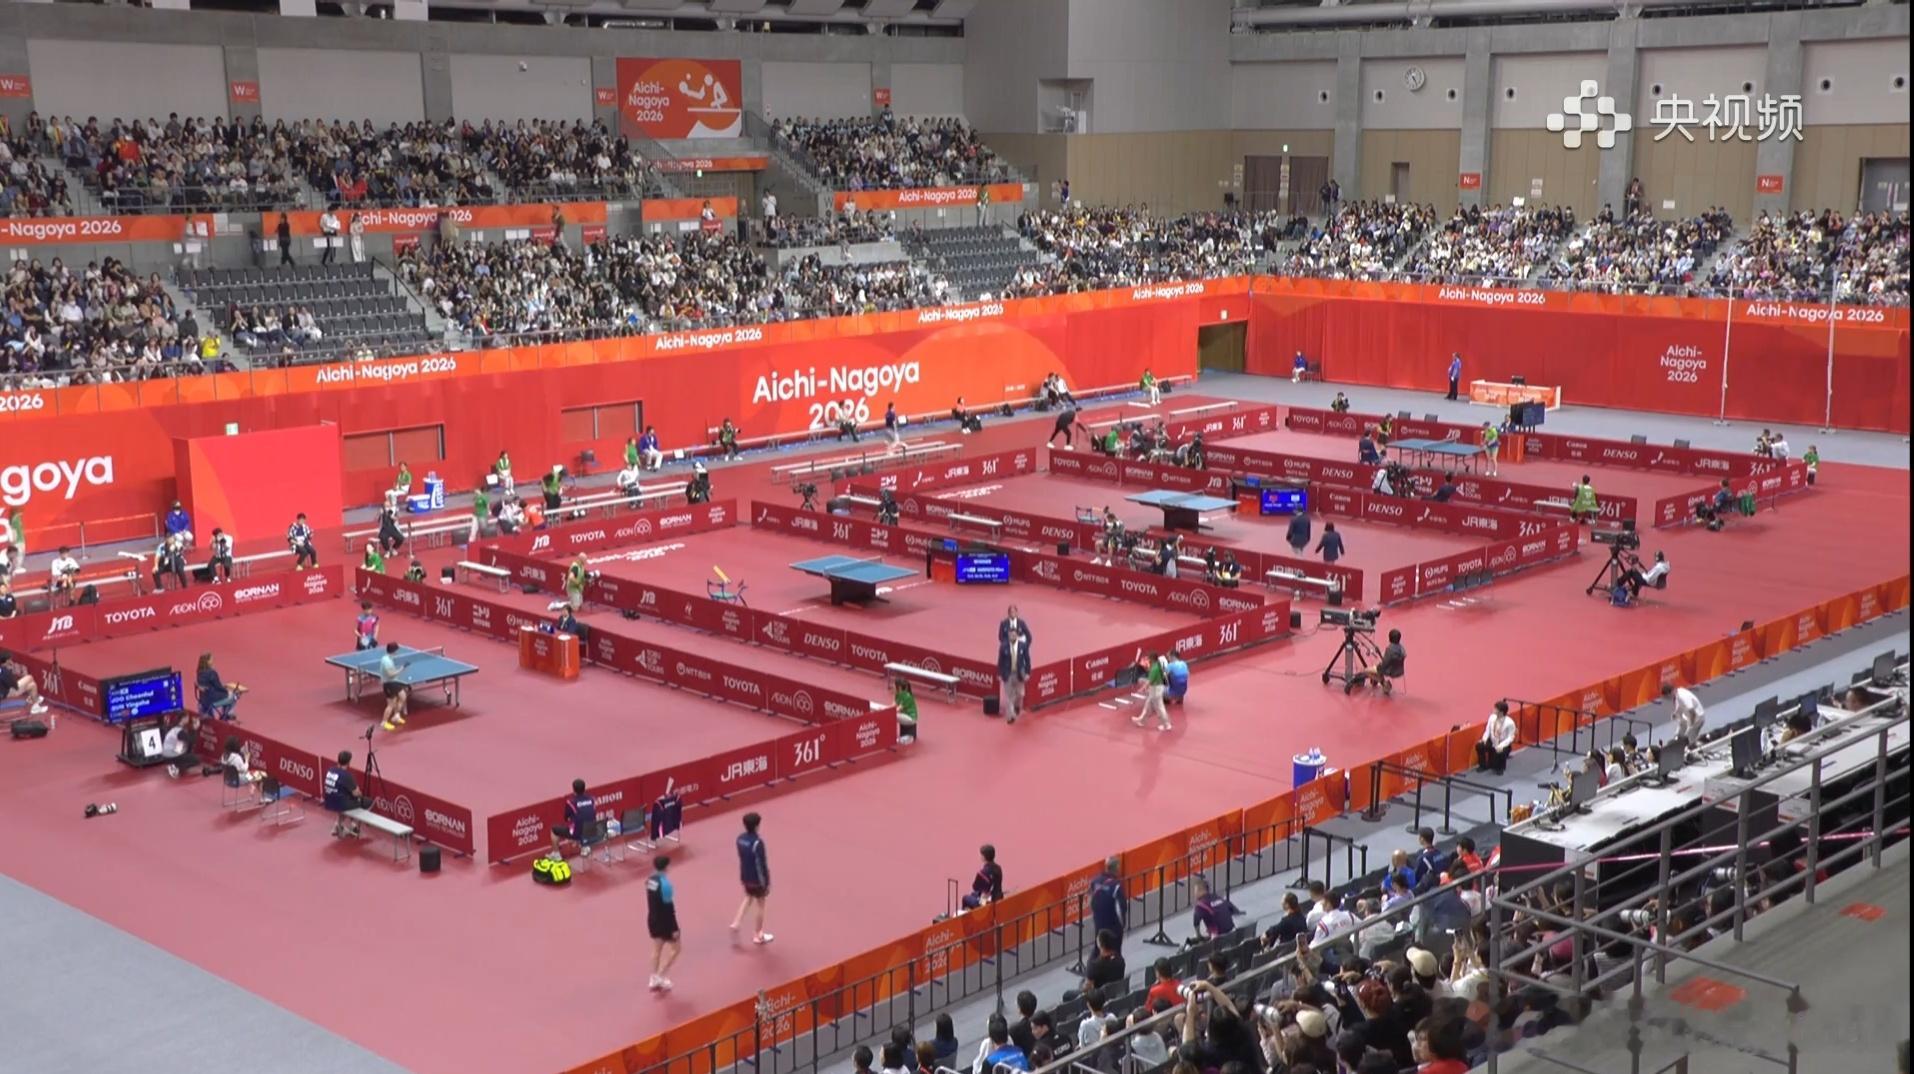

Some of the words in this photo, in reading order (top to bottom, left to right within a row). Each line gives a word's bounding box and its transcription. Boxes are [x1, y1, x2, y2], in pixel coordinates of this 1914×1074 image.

[633, 82, 664, 93] Aichi-
[628, 95, 670, 108] Nagoya
[637, 110, 663, 122] 2026
[899, 192, 955, 203] Aichi-Nagoya
[957, 189, 977, 200] 2026
[360, 212, 437, 228] ichi-Nagoya
[450, 209, 473, 221] 026
[80, 220, 122, 235] 2026
[1133, 286, 1183, 300] Aichi-Nagoya
[1185, 283, 1204, 294] 2026
[1439, 288, 1514, 305] Aichi-Nagoya
[1517, 292, 1546, 305] 2026
[918, 306, 979, 323] Aichi-Nagoya
[981, 304, 1004, 316] 2026
[1746, 303, 1843, 331] Aichi-Nagoya
[1846, 309, 1884, 323] 2026
[656, 332, 732, 350] Aichi-Nagoya
[735, 328, 762, 342] 2026
[1667, 345, 1702, 358] Aichi-
[317, 361, 417, 383] Aichi-Nagoya
[421, 358, 456, 372] 2026
[1660, 356, 1707, 370] Nagoya
[753, 359, 919, 404] Aichi-Nagoya
[1667, 370, 1698, 383] 2026
[1293, 415, 1319, 425] TOYOTA
[1566, 440, 1587, 449] Canon
[1603, 448, 1637, 460] DENSO
[982, 457, 999, 475] 361°
[1053, 457, 1080, 469] TOYOTA
[1695, 457, 1730, 470] JR東海
[1322, 467, 1353, 480] DENSO
[1329, 492, 1351, 502] Canon
[1368, 502, 1403, 517] DENSO
[1599, 500, 1626, 517] 361°
[833, 522, 853, 539] 361°
[1462, 515, 1498, 531] JR東海
[571, 530, 605, 544] TOYOTA
[1042, 526, 1074, 540] DENSO
[532, 535, 550, 550] JTB
[1458, 558, 1483, 573] TOYOTA
[598, 580, 618, 591] Canon
[1121, 579, 1157, 596] TOYOTA
[640, 591, 656, 604] JTB
[169, 602, 197, 616] ÆON
[435, 596, 455, 618] 361°
[104, 606, 156, 624] TOYOTA
[48, 615, 74, 635] JTB
[1219, 619, 1242, 645] 361°
[804, 632, 840, 651] DENSO
[851, 644, 888, 663] TOYOTA
[1085, 656, 1109, 671] Canon
[78, 679, 98, 695] Canon
[723, 675, 761, 695] TOYOTA
[148, 735, 156, 749] 4
[793, 733, 826, 767] 361°
[279, 757, 314, 781] DENSO
[720, 756, 768, 782] JR東海
[594, 791, 623, 807] anon
[517, 816, 540, 828] Aichi-
[512, 823, 543, 838] Nagoya
[517, 834, 538, 847] 2026
